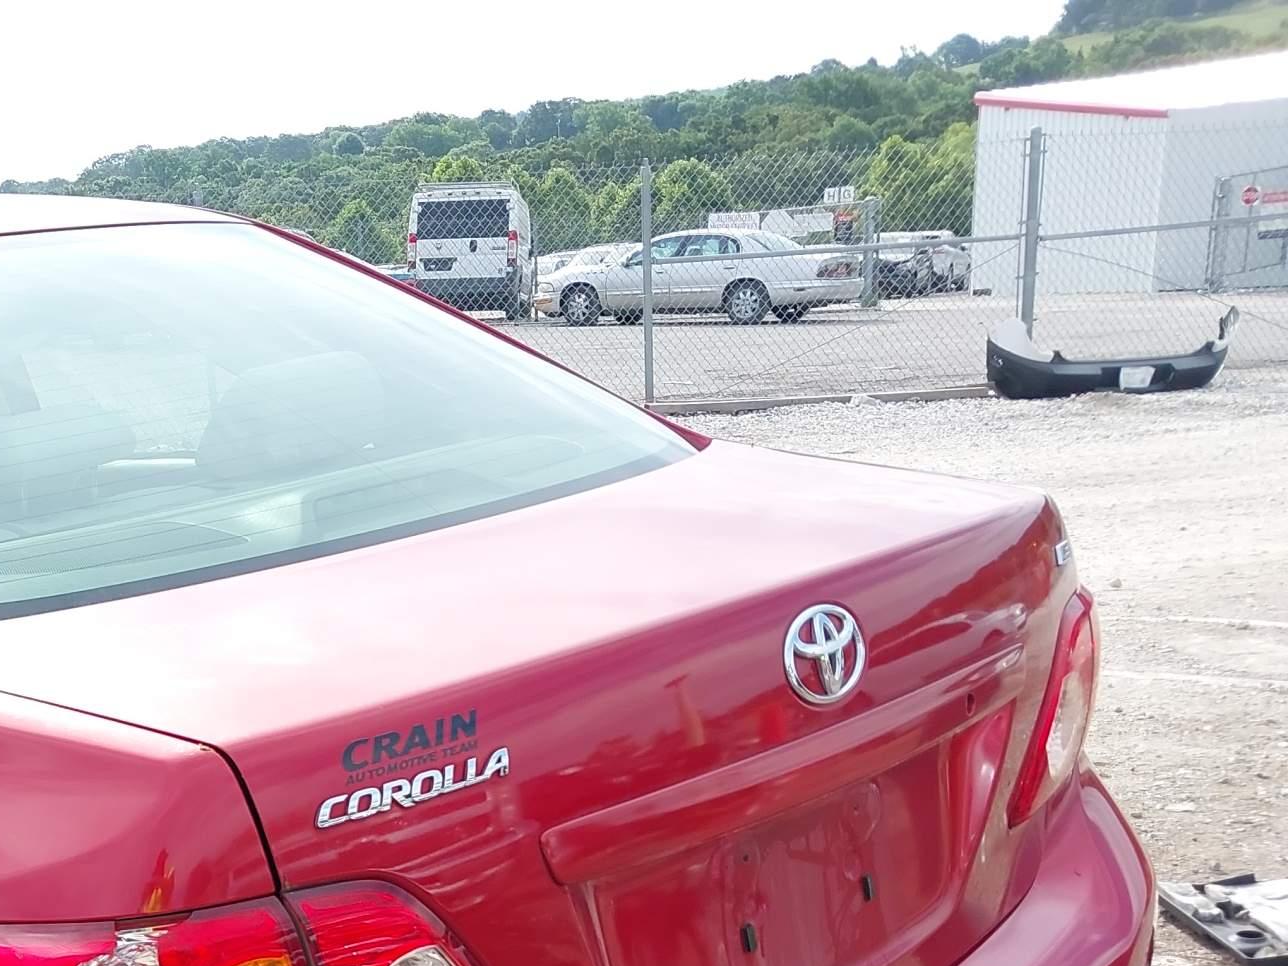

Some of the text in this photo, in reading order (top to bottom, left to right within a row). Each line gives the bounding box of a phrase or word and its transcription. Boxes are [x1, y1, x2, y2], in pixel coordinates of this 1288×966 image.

[341, 709, 478, 773] CRAIN
[345, 740, 479, 786] AUTOMOTIVE TEAM
[315, 746, 510, 829] COROLLA
